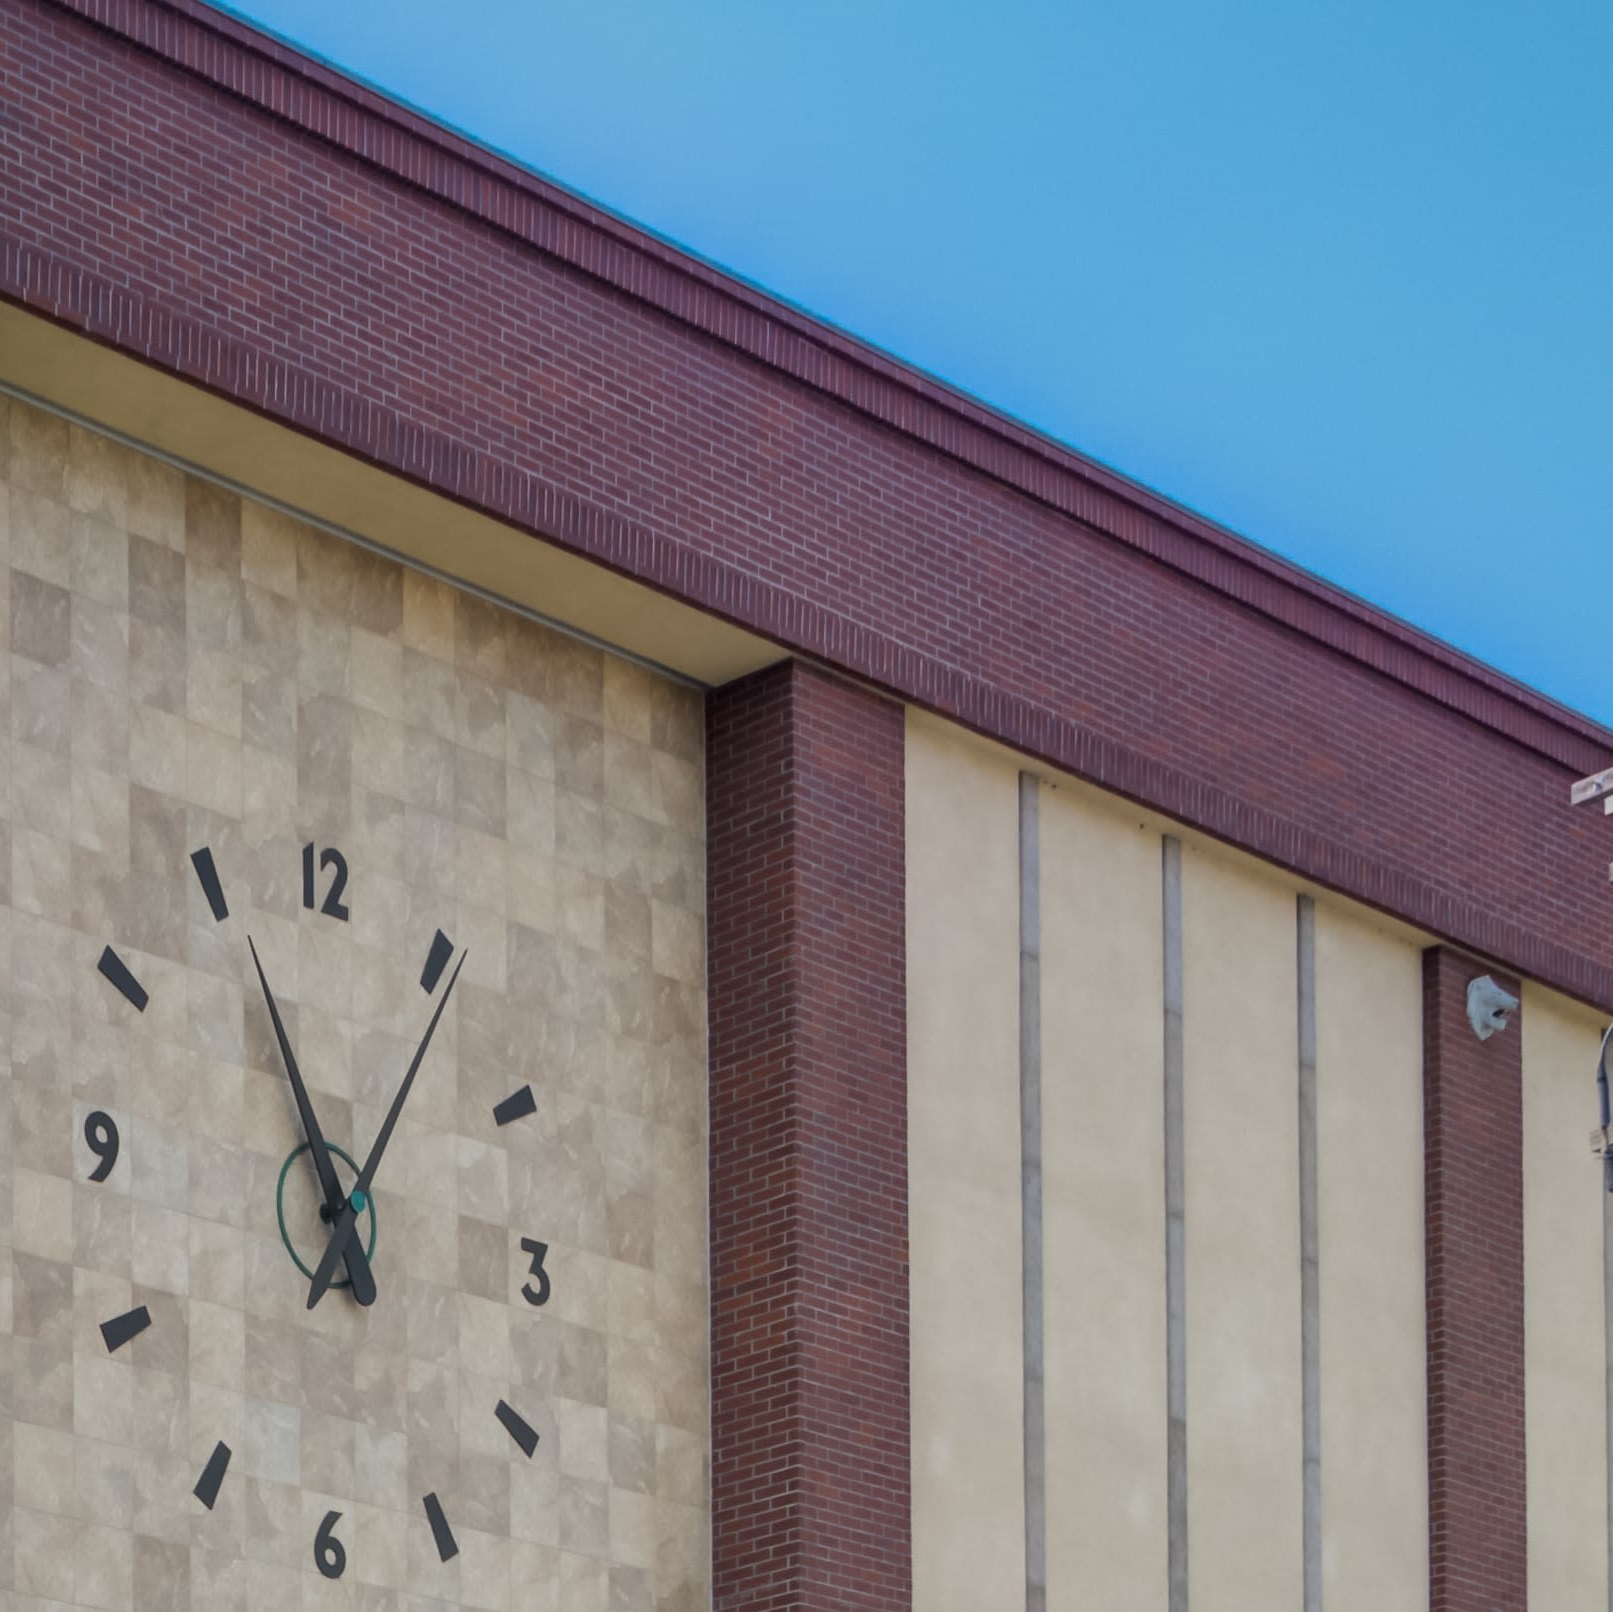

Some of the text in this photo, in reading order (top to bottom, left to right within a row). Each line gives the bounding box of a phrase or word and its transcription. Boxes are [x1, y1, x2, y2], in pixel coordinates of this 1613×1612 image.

[302, 841, 350, 921] 12
[84, 1110, 120, 1182] 9
[520, 1237, 551, 1306] 3
[313, 1509, 347, 1579] 6
